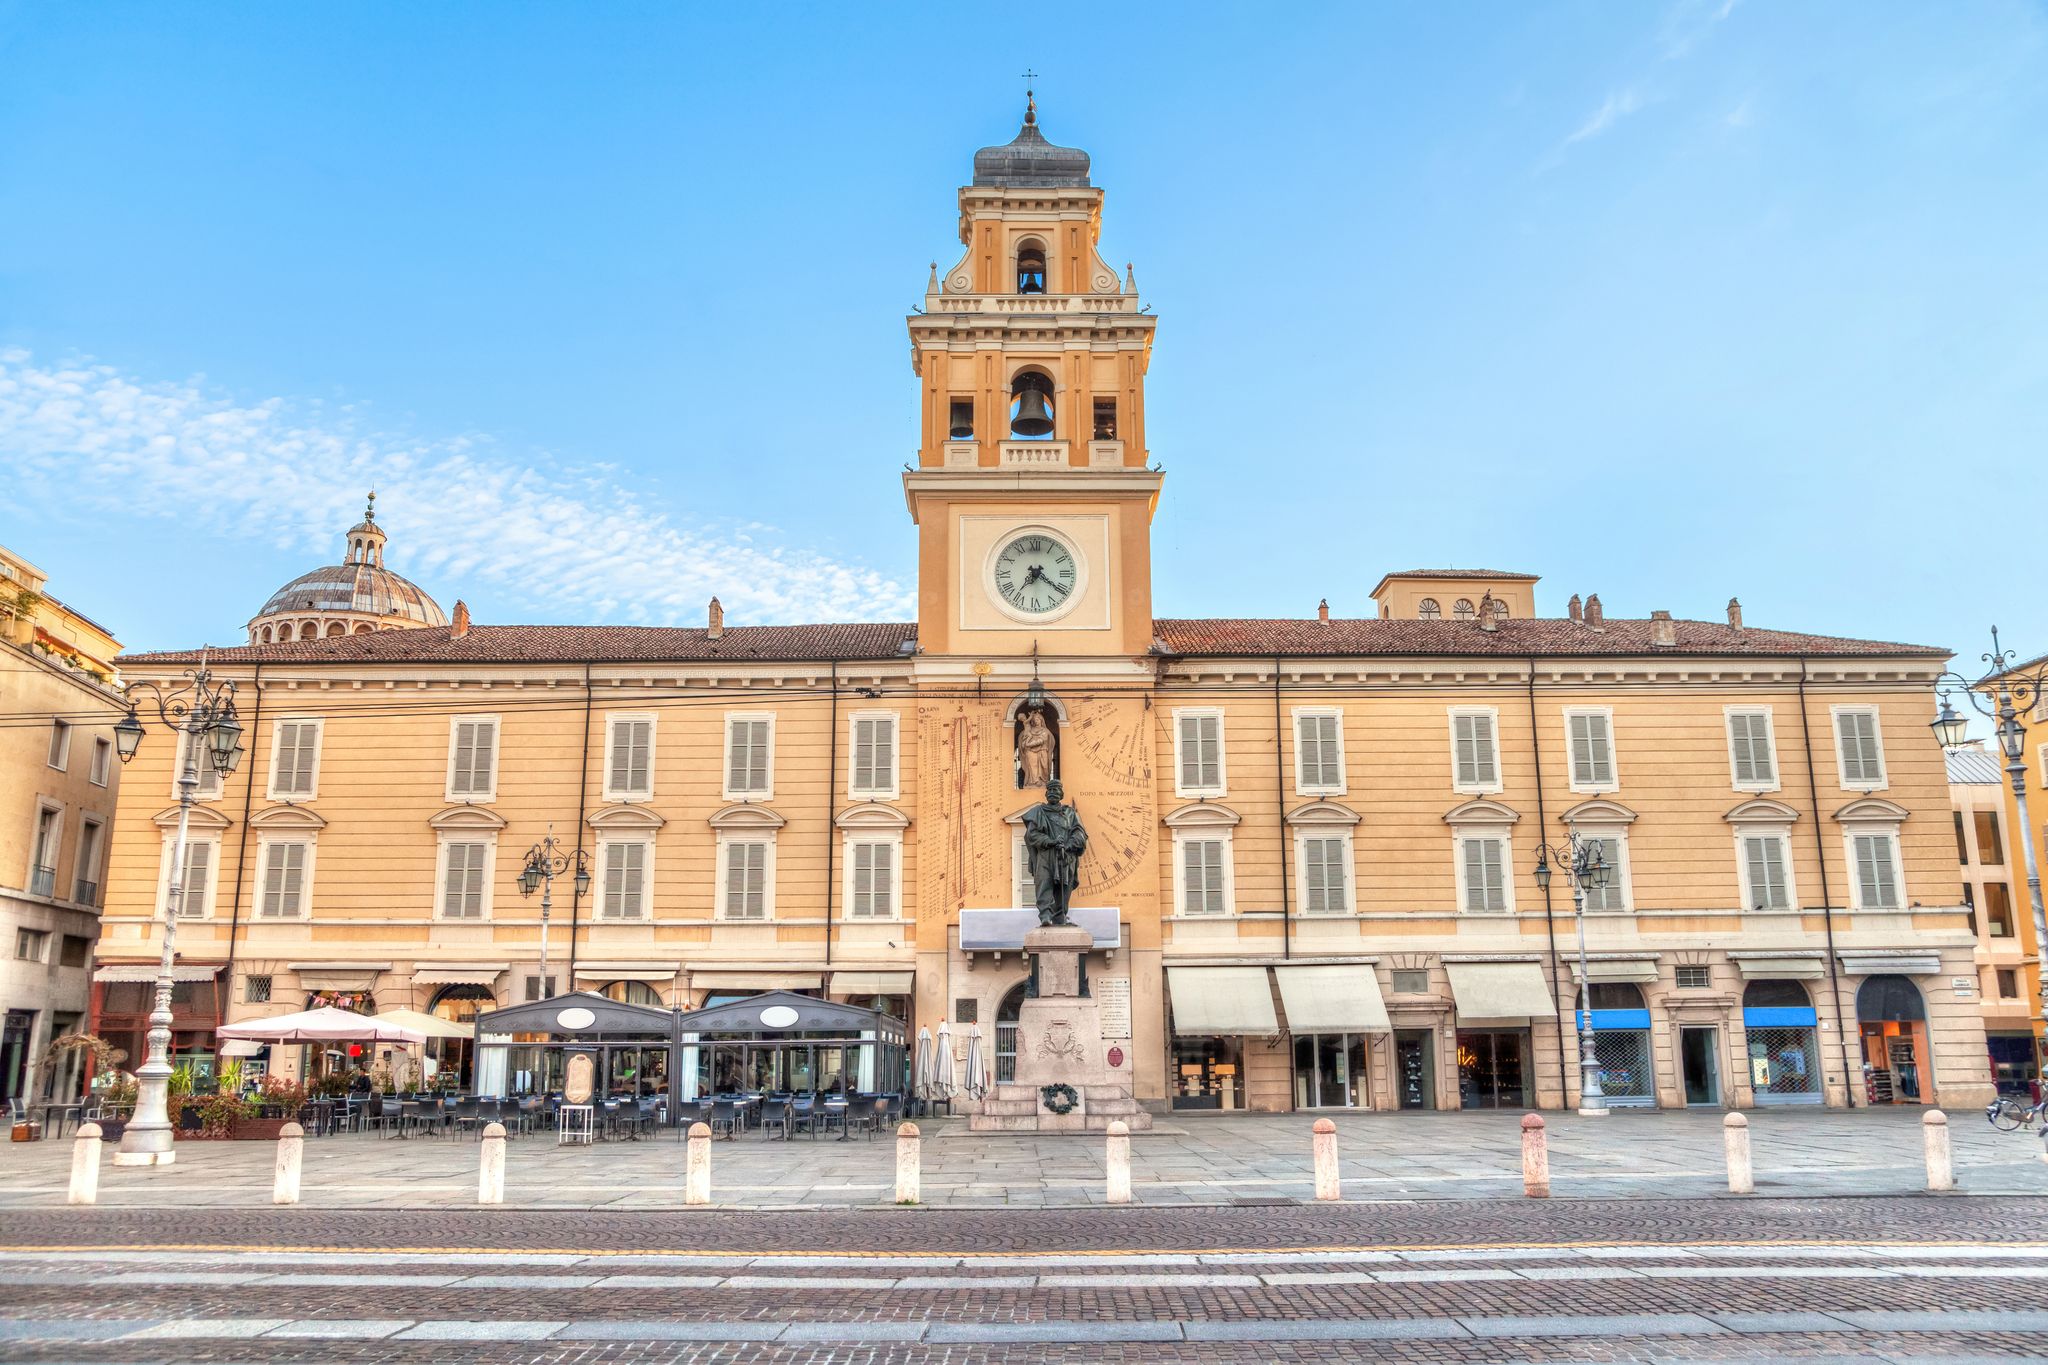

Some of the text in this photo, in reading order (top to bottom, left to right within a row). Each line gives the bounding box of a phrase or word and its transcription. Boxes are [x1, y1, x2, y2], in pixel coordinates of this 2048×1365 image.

[1014, 544, 1025, 555] XI
[1029, 541, 1041, 551] XII
[1003, 556, 1015, 564] X
[1056, 556, 1066, 564] II
[1000, 570, 1010, 578] IX
[1002, 582, 1015, 596] VIII
[1014, 592, 1024, 606] VII
[1031, 597, 1041, 608] VI
[1048, 595, 1056, 605] V
